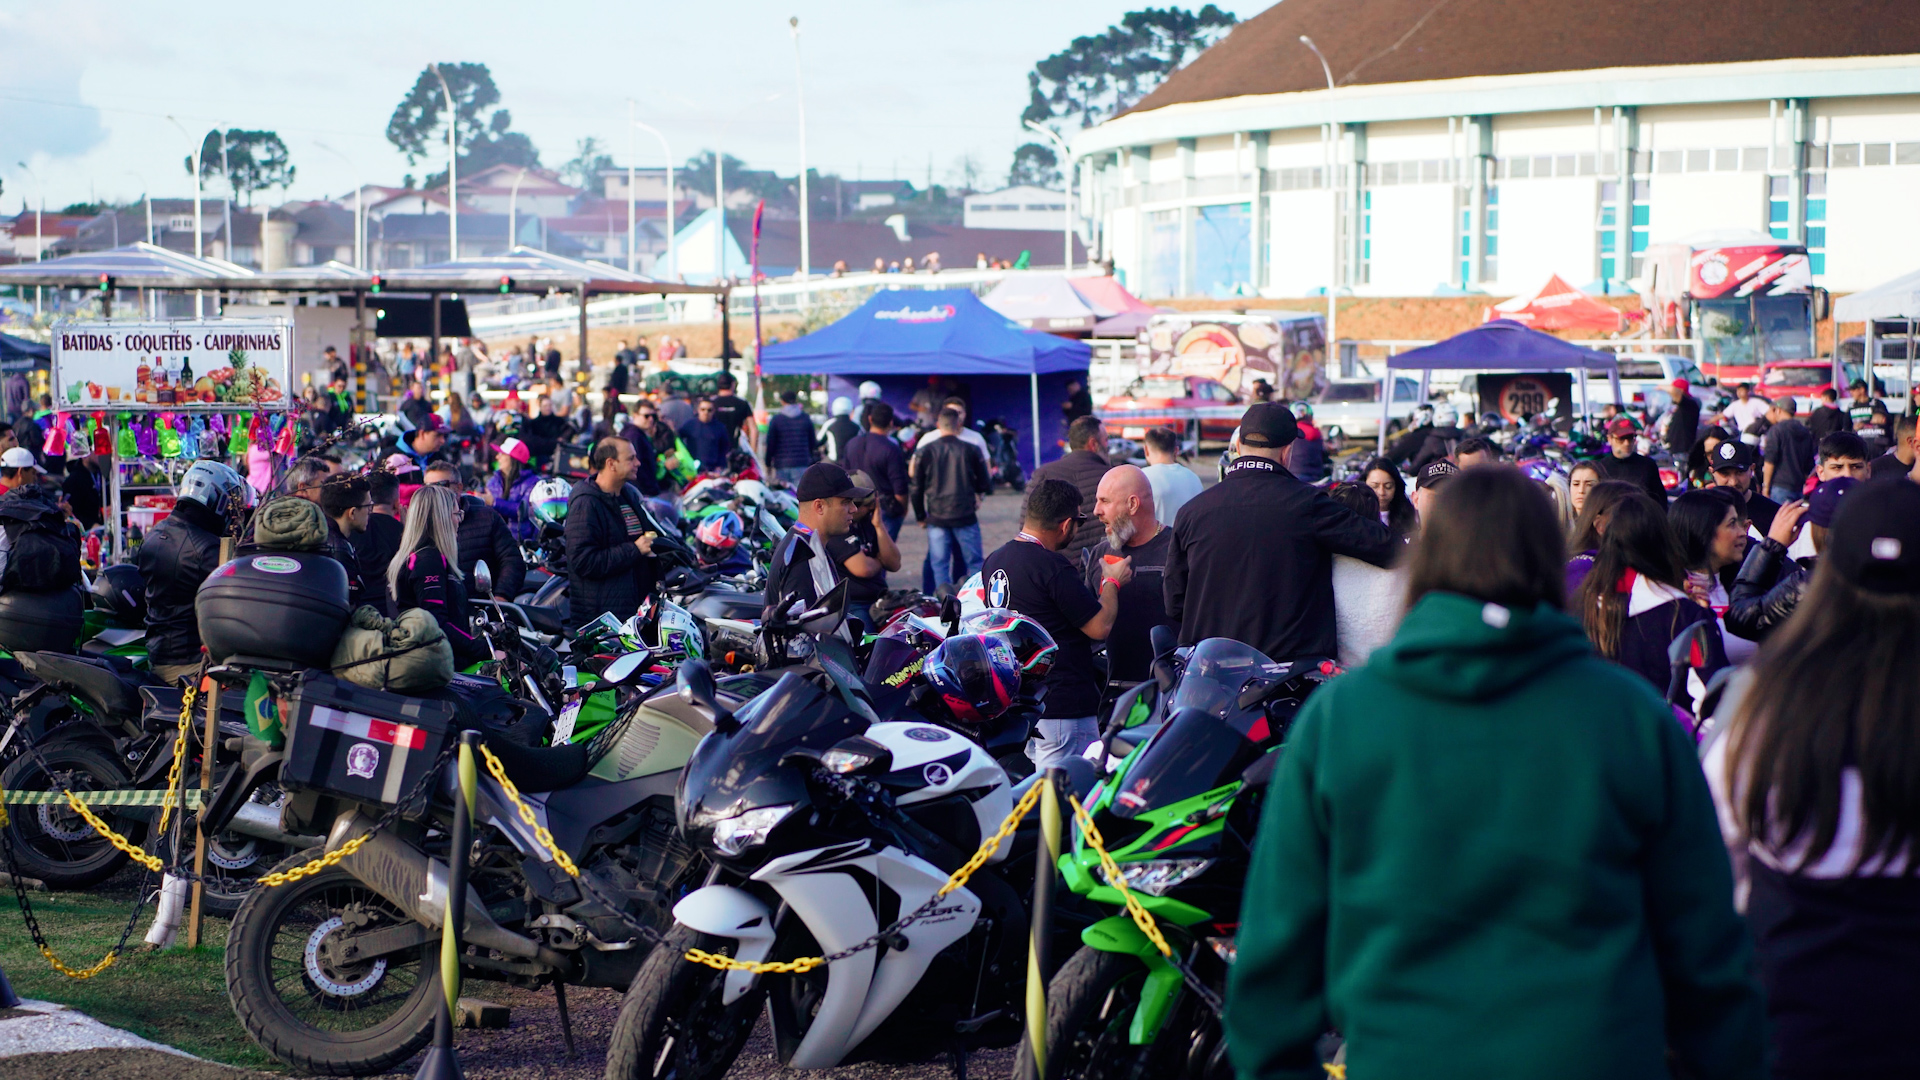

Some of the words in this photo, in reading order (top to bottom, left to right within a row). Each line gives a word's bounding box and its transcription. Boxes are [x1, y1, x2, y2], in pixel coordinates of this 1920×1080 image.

[62, 334, 113, 351] BATIDAS
[125, 329, 192, 353] COQUETÉIS
[204, 334, 281, 351] CAIPIRINHAS
[1509, 393, 1544, 415] 299
